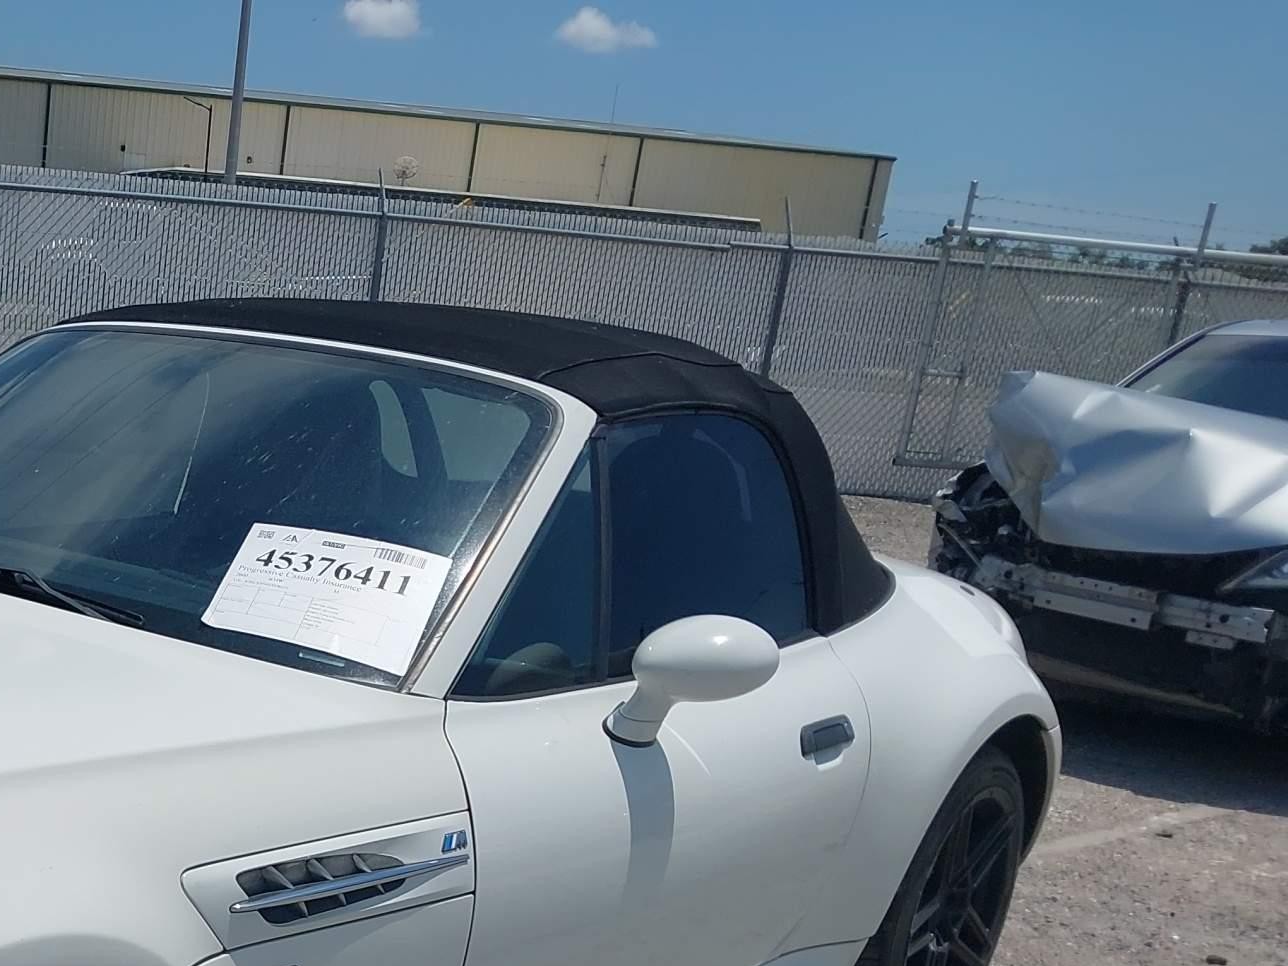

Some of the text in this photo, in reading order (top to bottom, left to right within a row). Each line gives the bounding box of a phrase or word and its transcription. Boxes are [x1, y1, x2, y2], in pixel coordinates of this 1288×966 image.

[238, 564, 284, 578] Progressive
[285, 572, 320, 585] Casualty
[322, 578, 362, 593] Insurance
[255, 549, 411, 596] 45376411
